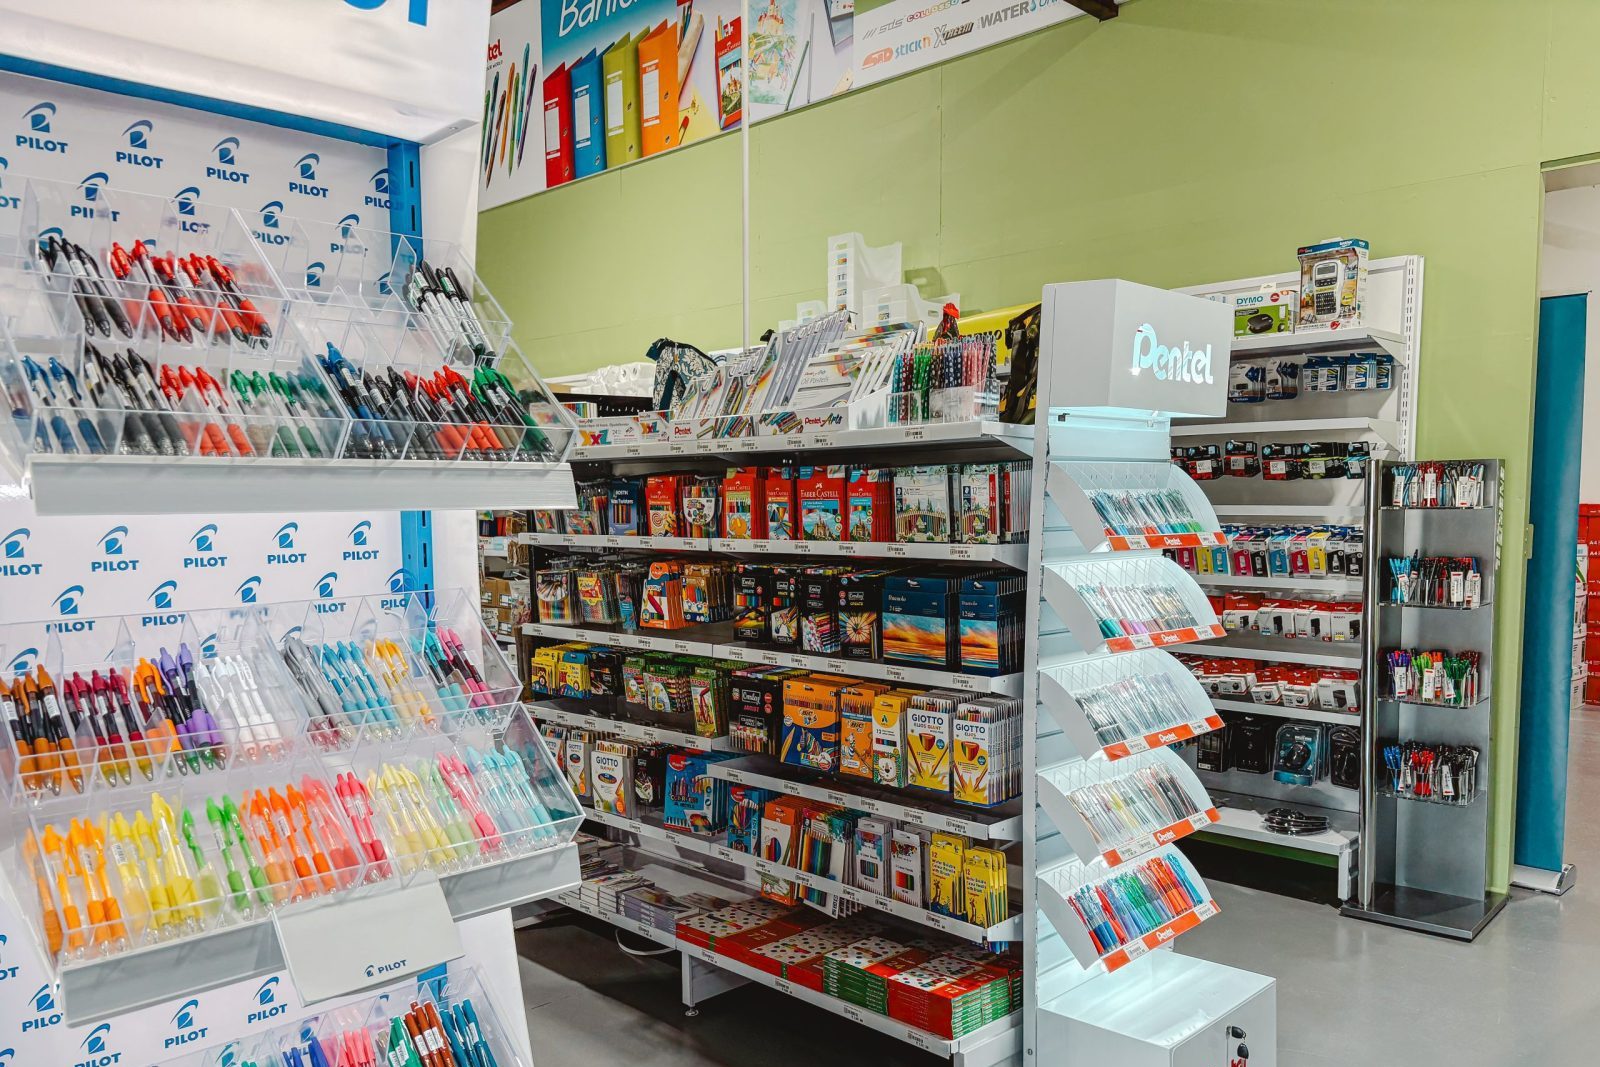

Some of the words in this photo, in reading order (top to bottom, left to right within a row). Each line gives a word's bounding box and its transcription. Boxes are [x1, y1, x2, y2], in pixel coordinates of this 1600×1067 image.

[980, 1, 1030, 28] WATER
[16, 135, 68, 153] PILOT
[116, 152, 164, 168] PILOT
[206, 166, 250, 184] PILOT
[289, 182, 328, 198] PILOT
[364, 196, 392, 210] PILO
[1236, 296, 1264, 304] DYMO
[1132, 323, 1214, 384] Pentel
[800, 489, 839, 498] FABER-CASTELL
[184, 556, 228, 568] PILOT
[268, 553, 306, 564] PILOT
[343, 550, 380, 561] PILOT
[92, 560, 139, 572] PILOT
[314, 602, 346, 614] ILOT
[381, 598, 406, 610] PILO
[912, 714, 944, 726] GIOTTO
[956, 724, 986, 734] GIOTTO
[596, 756, 618, 768] GIOTTO
[378, 960, 406, 974] PILOT
[248, 1003, 288, 1024] PILOT
[22, 1012, 63, 1032] PILO
[164, 1028, 208, 1048] PILOT
